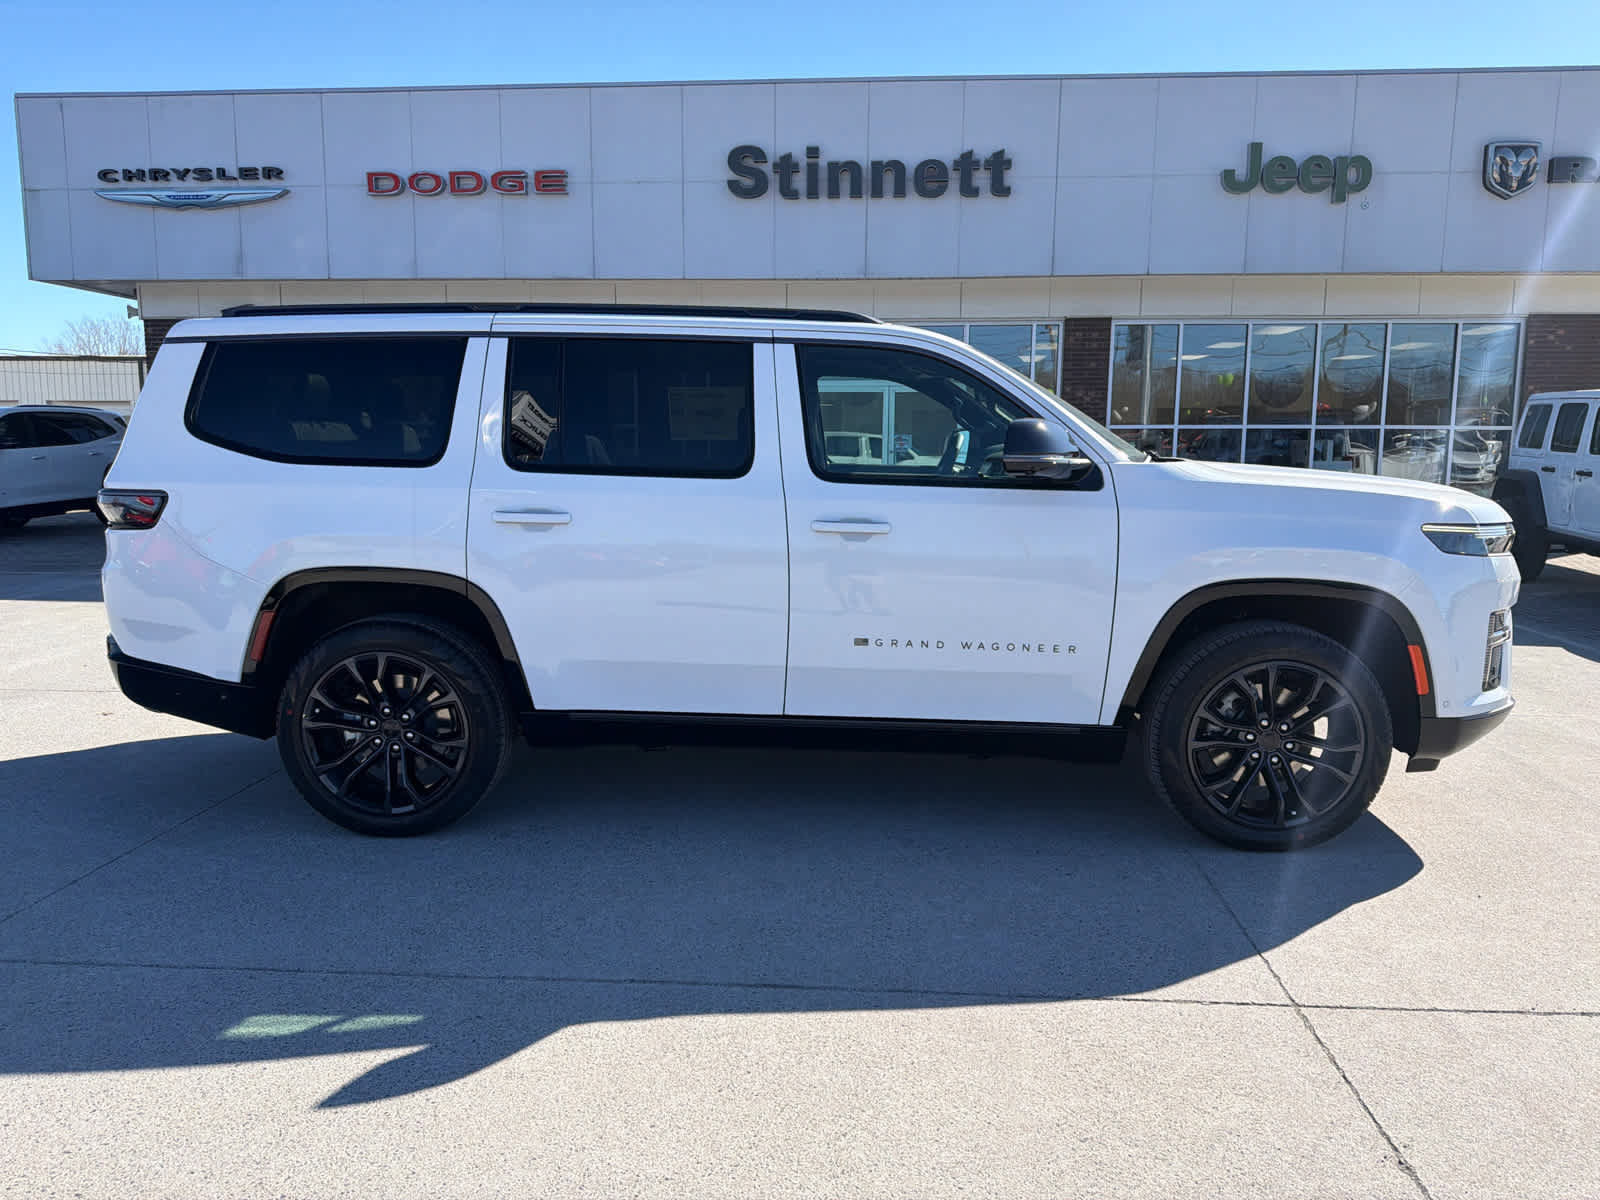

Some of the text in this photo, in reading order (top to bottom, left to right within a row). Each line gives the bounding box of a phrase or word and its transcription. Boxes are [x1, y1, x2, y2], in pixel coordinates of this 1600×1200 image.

[97, 166, 284, 184] CHRYSLER
[366, 169, 569, 197] DODGE
[727, 144, 1012, 200] Stinnett
[1220, 142, 1373, 204] Jeep
[1546, 156, 1600, 184] R
[874, 638, 1077, 655] GRAND WAGONEER
